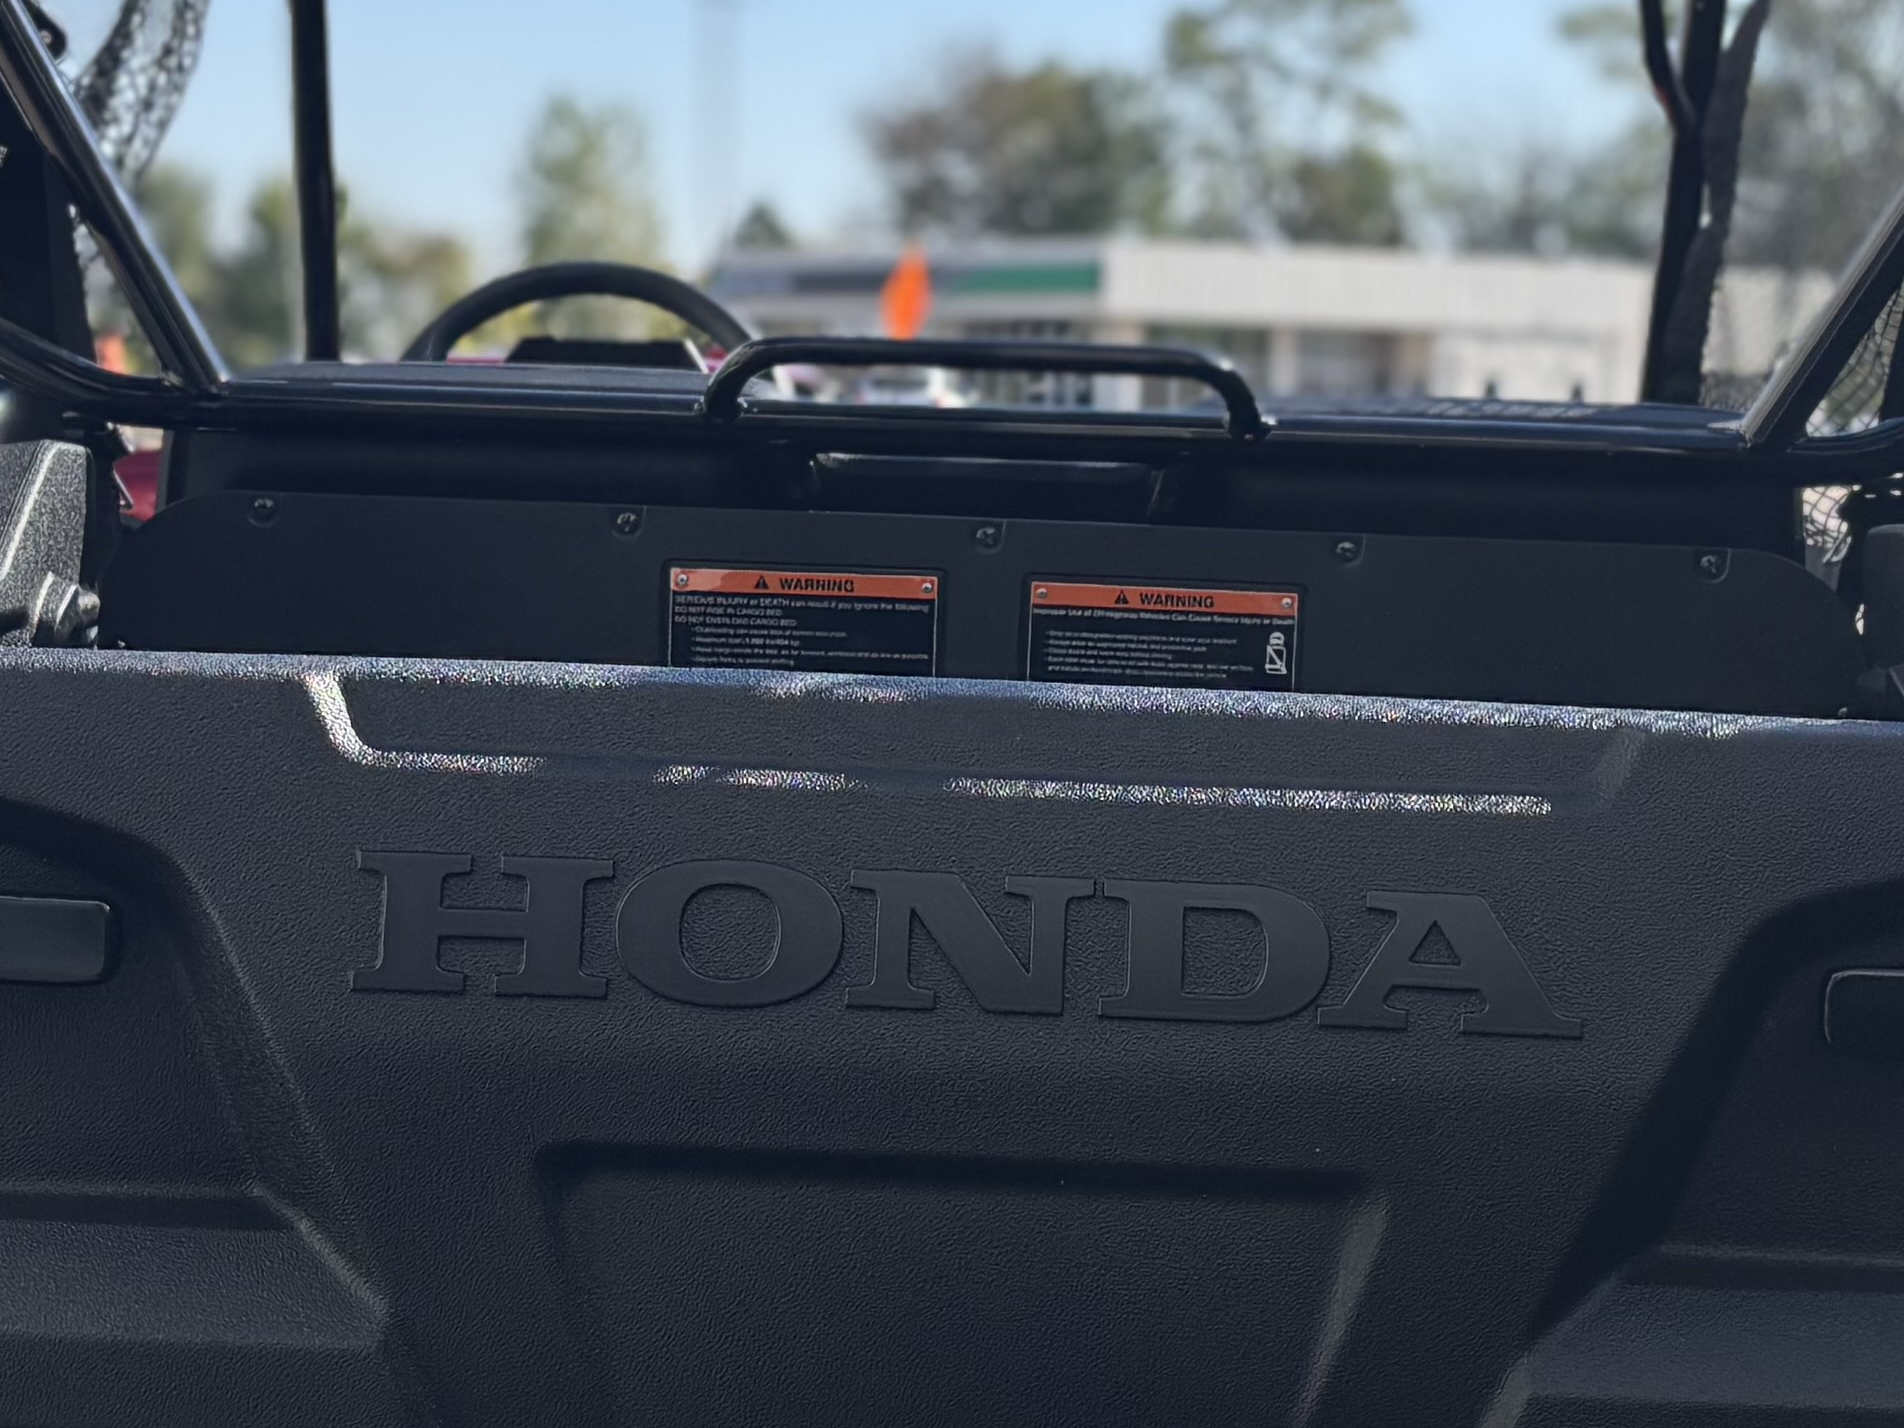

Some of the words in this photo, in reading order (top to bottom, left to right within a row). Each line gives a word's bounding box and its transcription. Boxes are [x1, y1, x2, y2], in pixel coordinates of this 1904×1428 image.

[779, 578, 855, 593] WARNING
[1139, 592, 1214, 608] WARNING
[348, 848, 1584, 1039] HONDA
